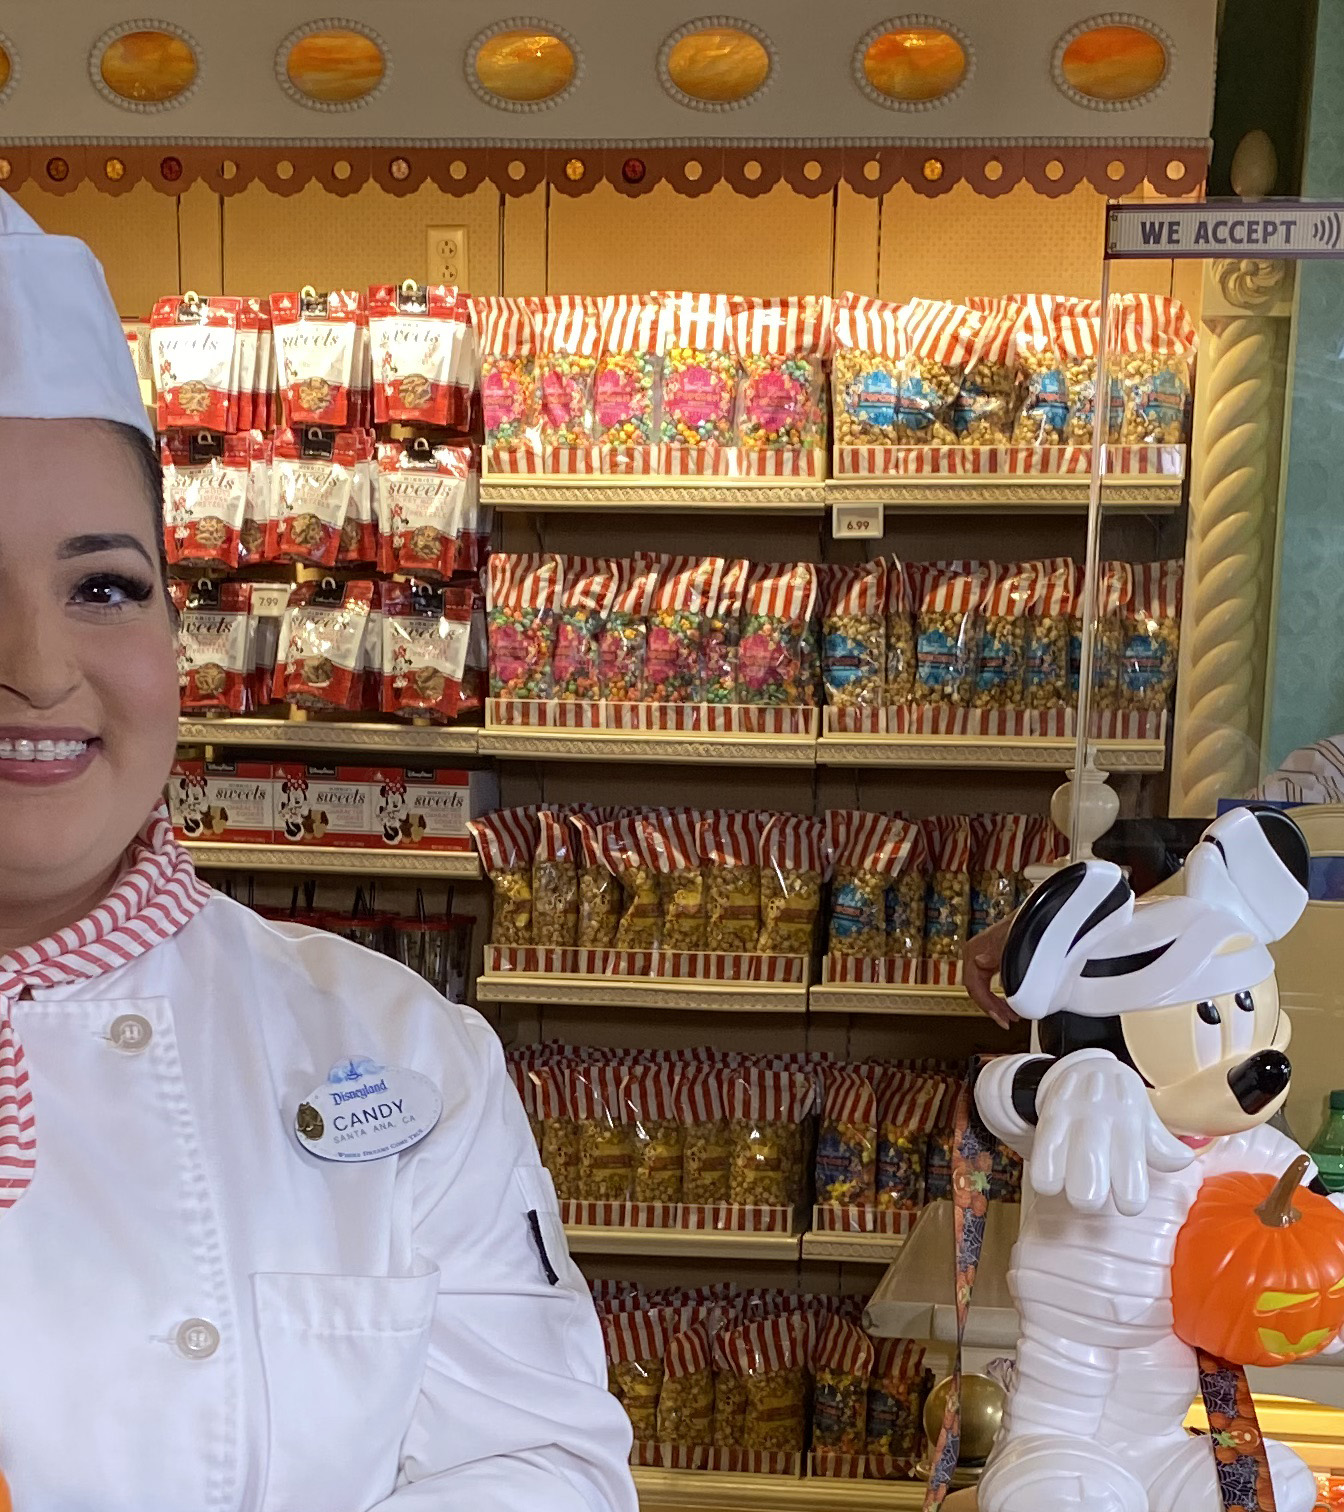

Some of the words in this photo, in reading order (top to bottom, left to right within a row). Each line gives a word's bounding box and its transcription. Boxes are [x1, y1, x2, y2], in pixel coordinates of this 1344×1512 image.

[1140, 220, 1181, 245] WE
[1194, 219, 1297, 245] ACCEPT
[388, 479, 452, 497] sweets
[846, 519, 870, 531] 6.99
[258, 597, 279, 607] 7.99
[215, 784, 267, 801] sweets
[316, 788, 366, 805] sweets
[414, 791, 464, 808] sweets
[329, 1078, 389, 1106] Disneyland
[333, 1098, 404, 1132] CANDY
[333, 1128, 367, 1144] SANTA
[401, 1114, 416, 1124] CA
